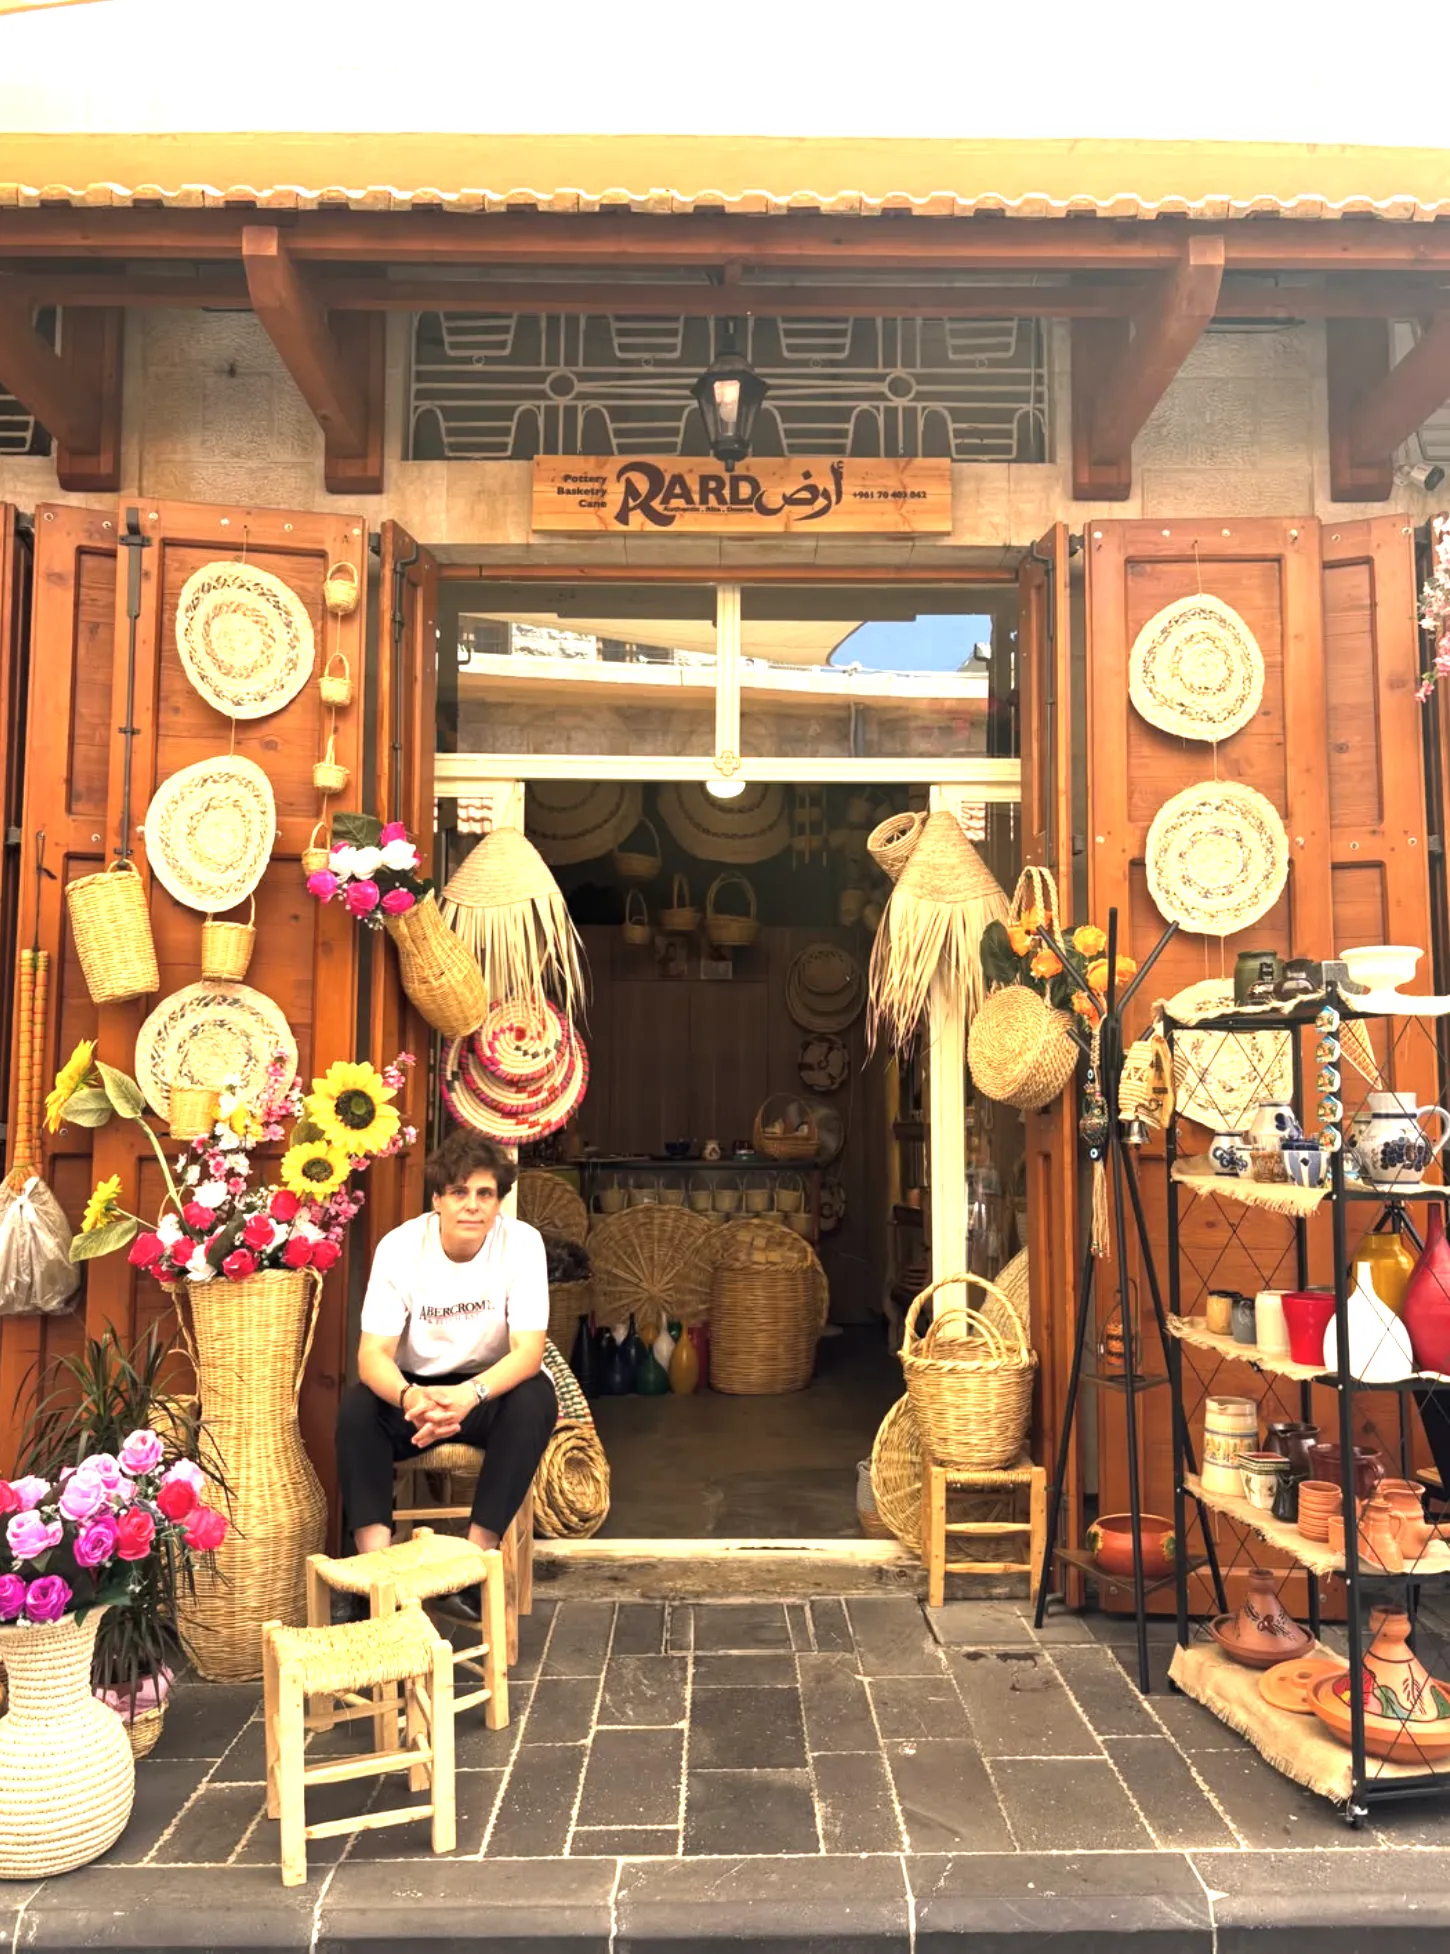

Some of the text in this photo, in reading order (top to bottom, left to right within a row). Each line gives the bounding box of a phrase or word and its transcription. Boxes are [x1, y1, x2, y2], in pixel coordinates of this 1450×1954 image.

[563, 474, 607, 485] Pottery
[557, 486, 607, 497] Basketry
[754, 460, 844, 521] أرض
[852, 490, 874, 499] +961
[877, 490, 889, 499] 70
[578, 499, 607, 508] Cane
